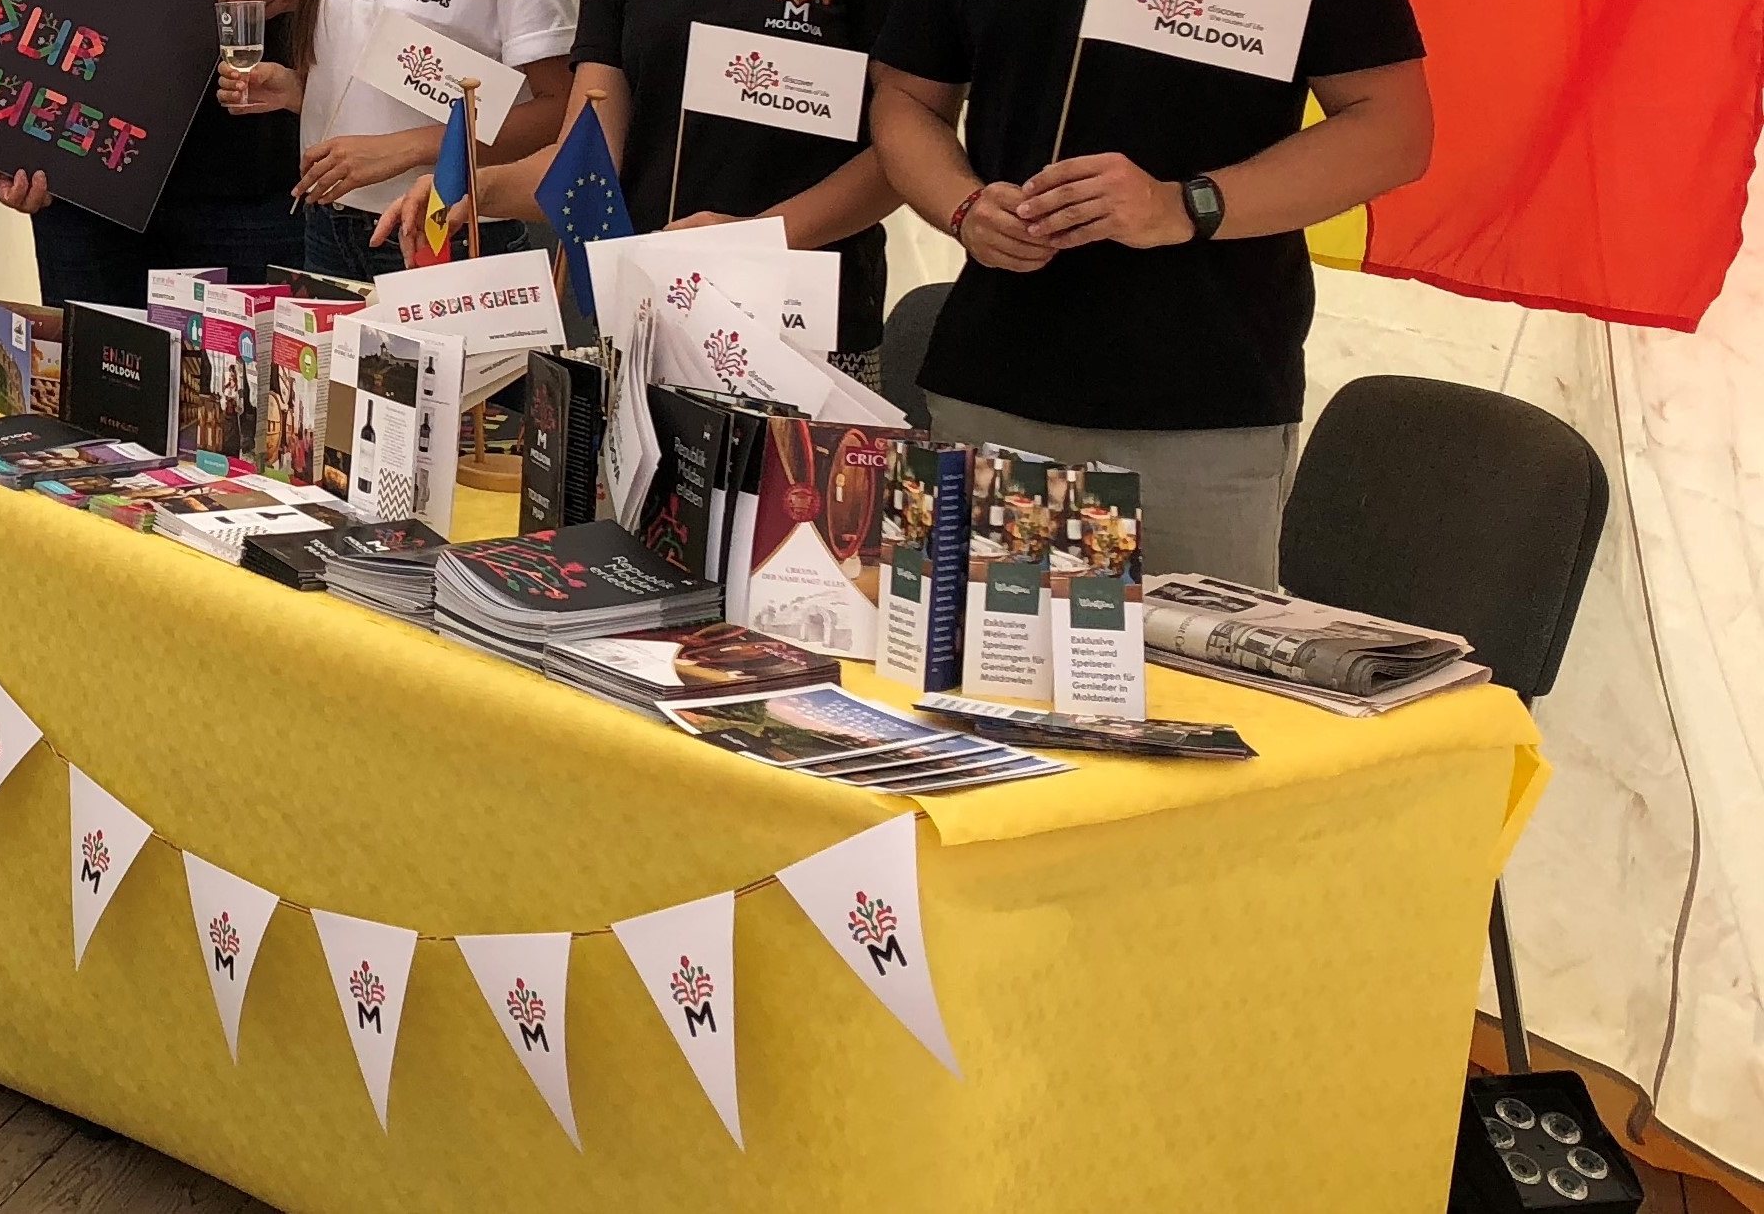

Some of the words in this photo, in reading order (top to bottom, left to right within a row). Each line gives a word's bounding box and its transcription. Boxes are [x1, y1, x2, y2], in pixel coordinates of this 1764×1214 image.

[764, 17, 823, 37] MOLDOVA
[1154, 16, 1264, 55] MOLDOVA
[741, 88, 832, 118] MOLDOVA
[398, 304, 423, 323] BE
[429, 295, 476, 319] OUR
[479, 286, 541, 309] GUEST
[102, 362, 141, 381] MOLDOVA
[103, 346, 142, 370] ENJOY
[81, 859, 102, 894] M
[215, 946, 235, 980] M
[867, 935, 909, 976] M
[358, 1001, 382, 1034] M
[683, 1001, 718, 1038] M
[519, 1024, 550, 1053] M
